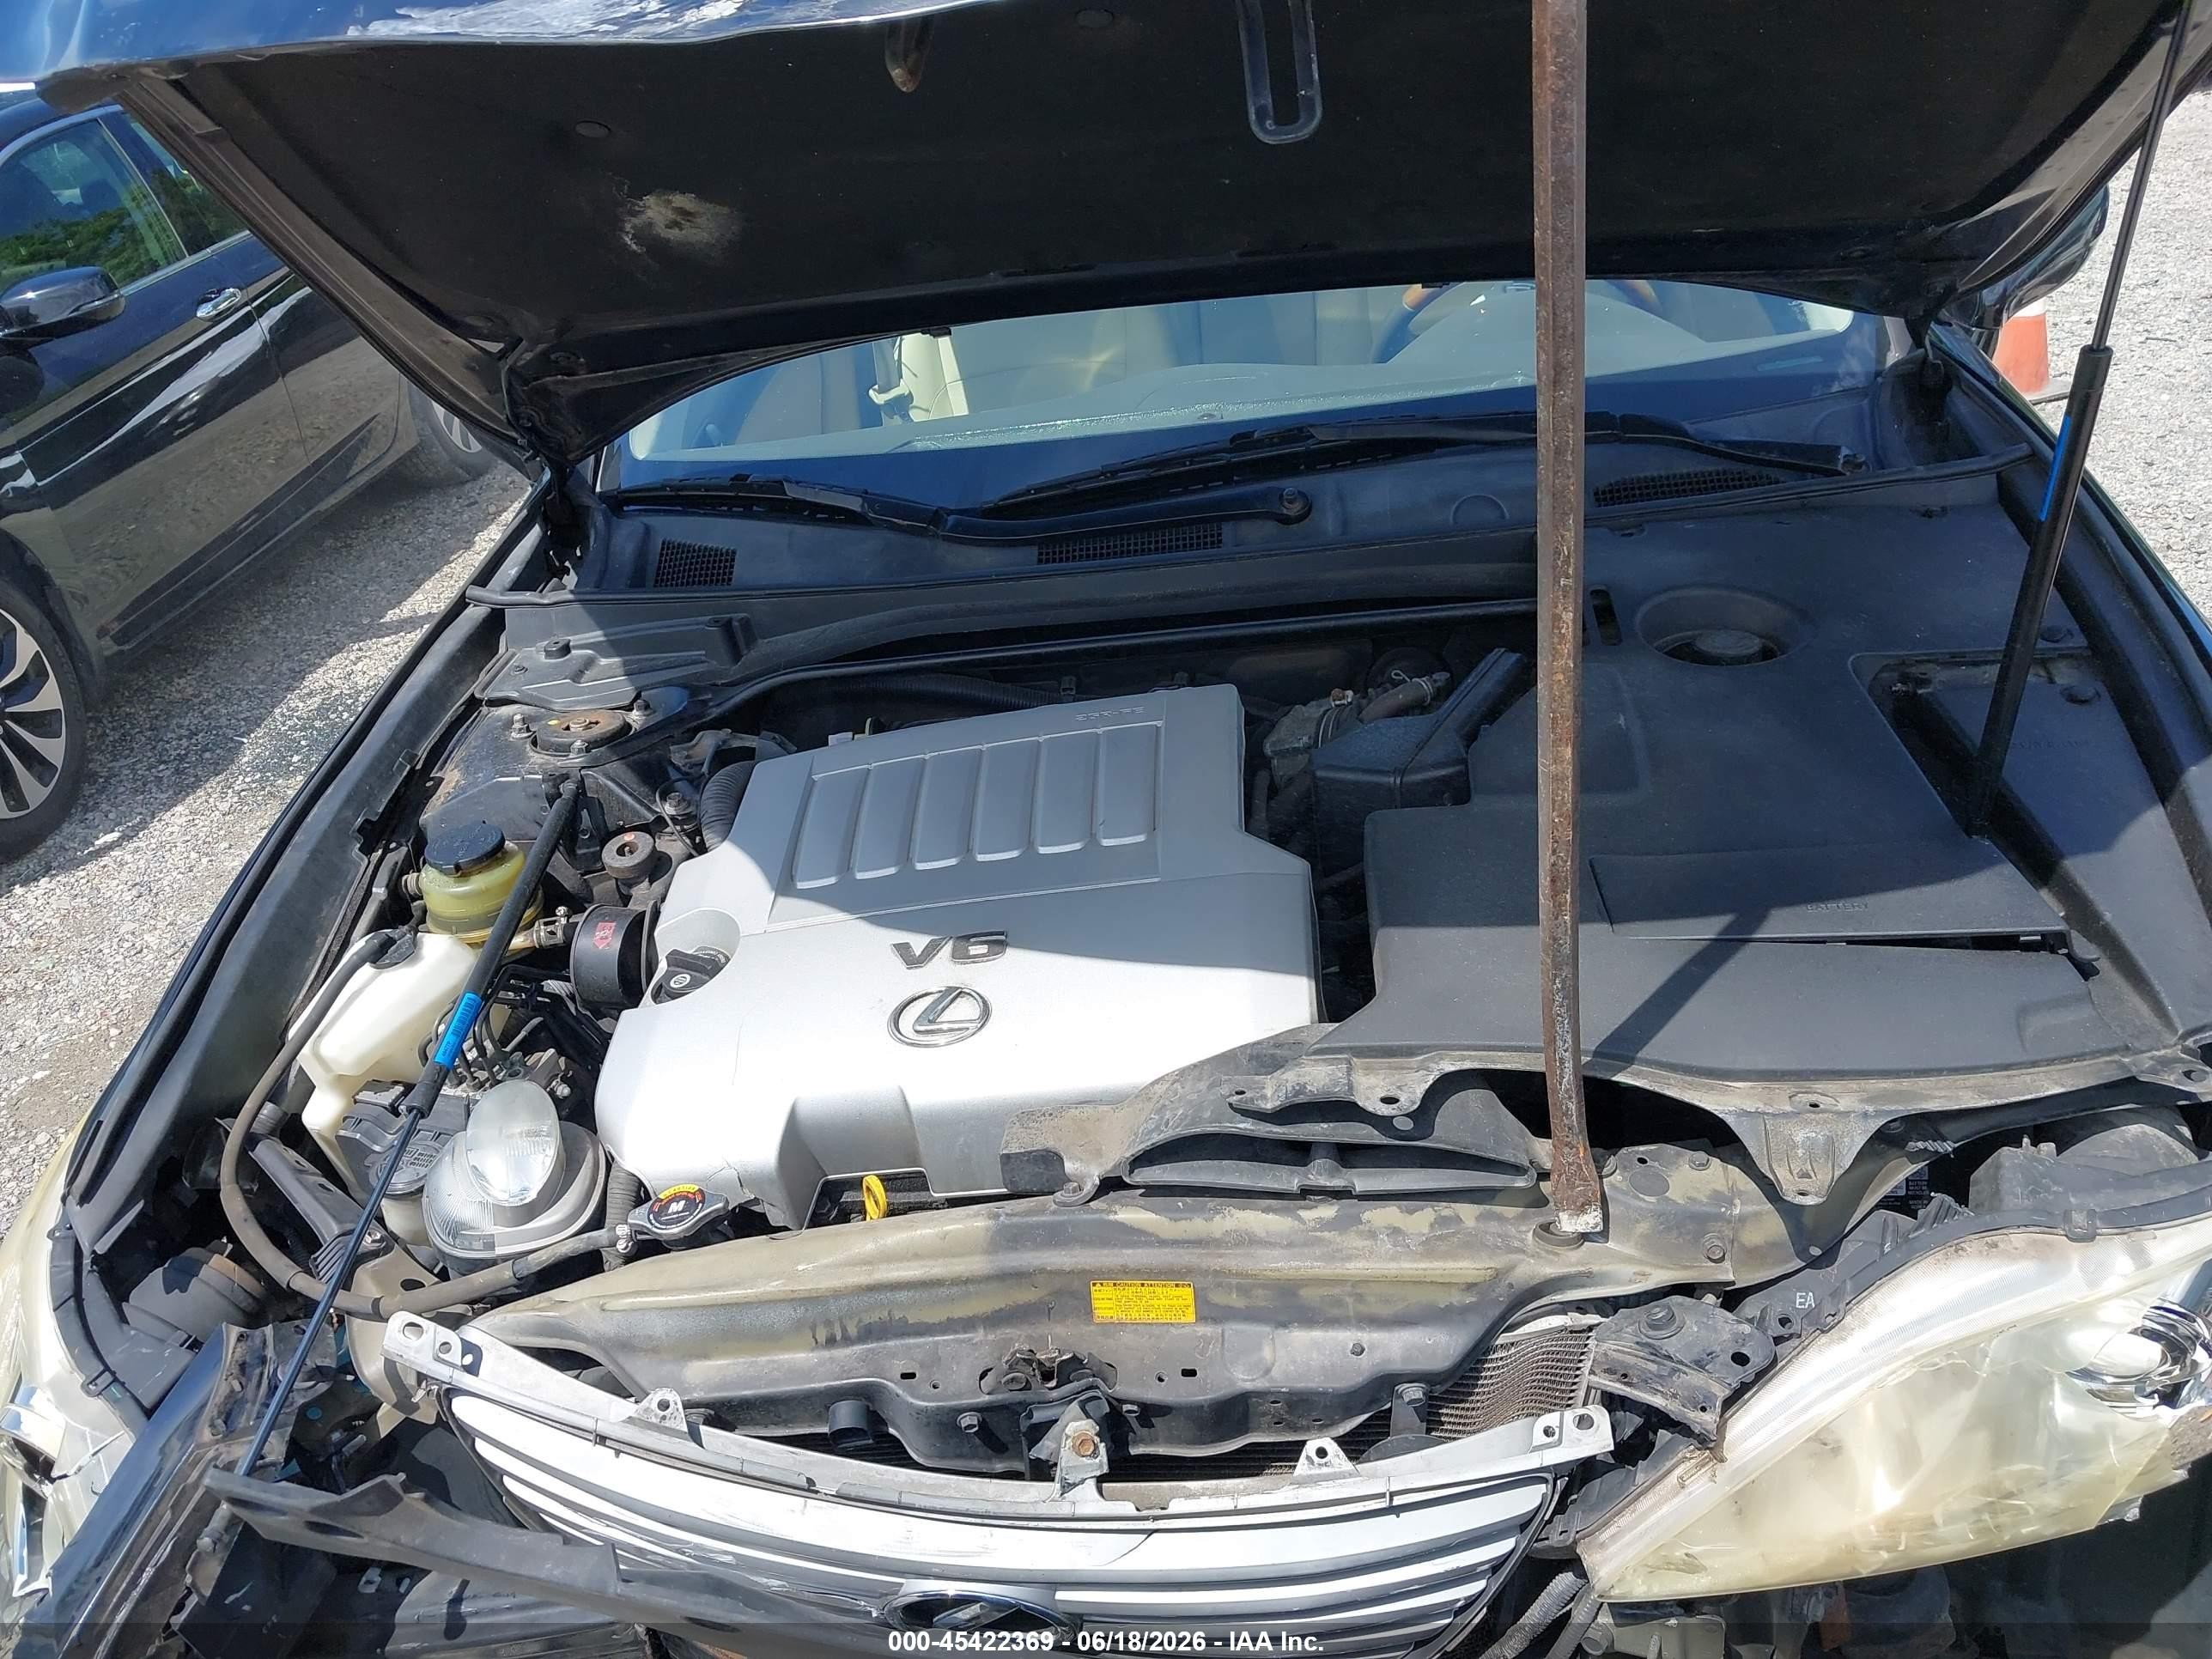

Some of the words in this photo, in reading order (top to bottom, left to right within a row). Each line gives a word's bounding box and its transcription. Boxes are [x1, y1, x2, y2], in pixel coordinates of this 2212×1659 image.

[1807, 902, 1869, 913] BATTERY
[891, 930, 1008, 969] V6
[1796, 1291, 1815, 1309] EA
